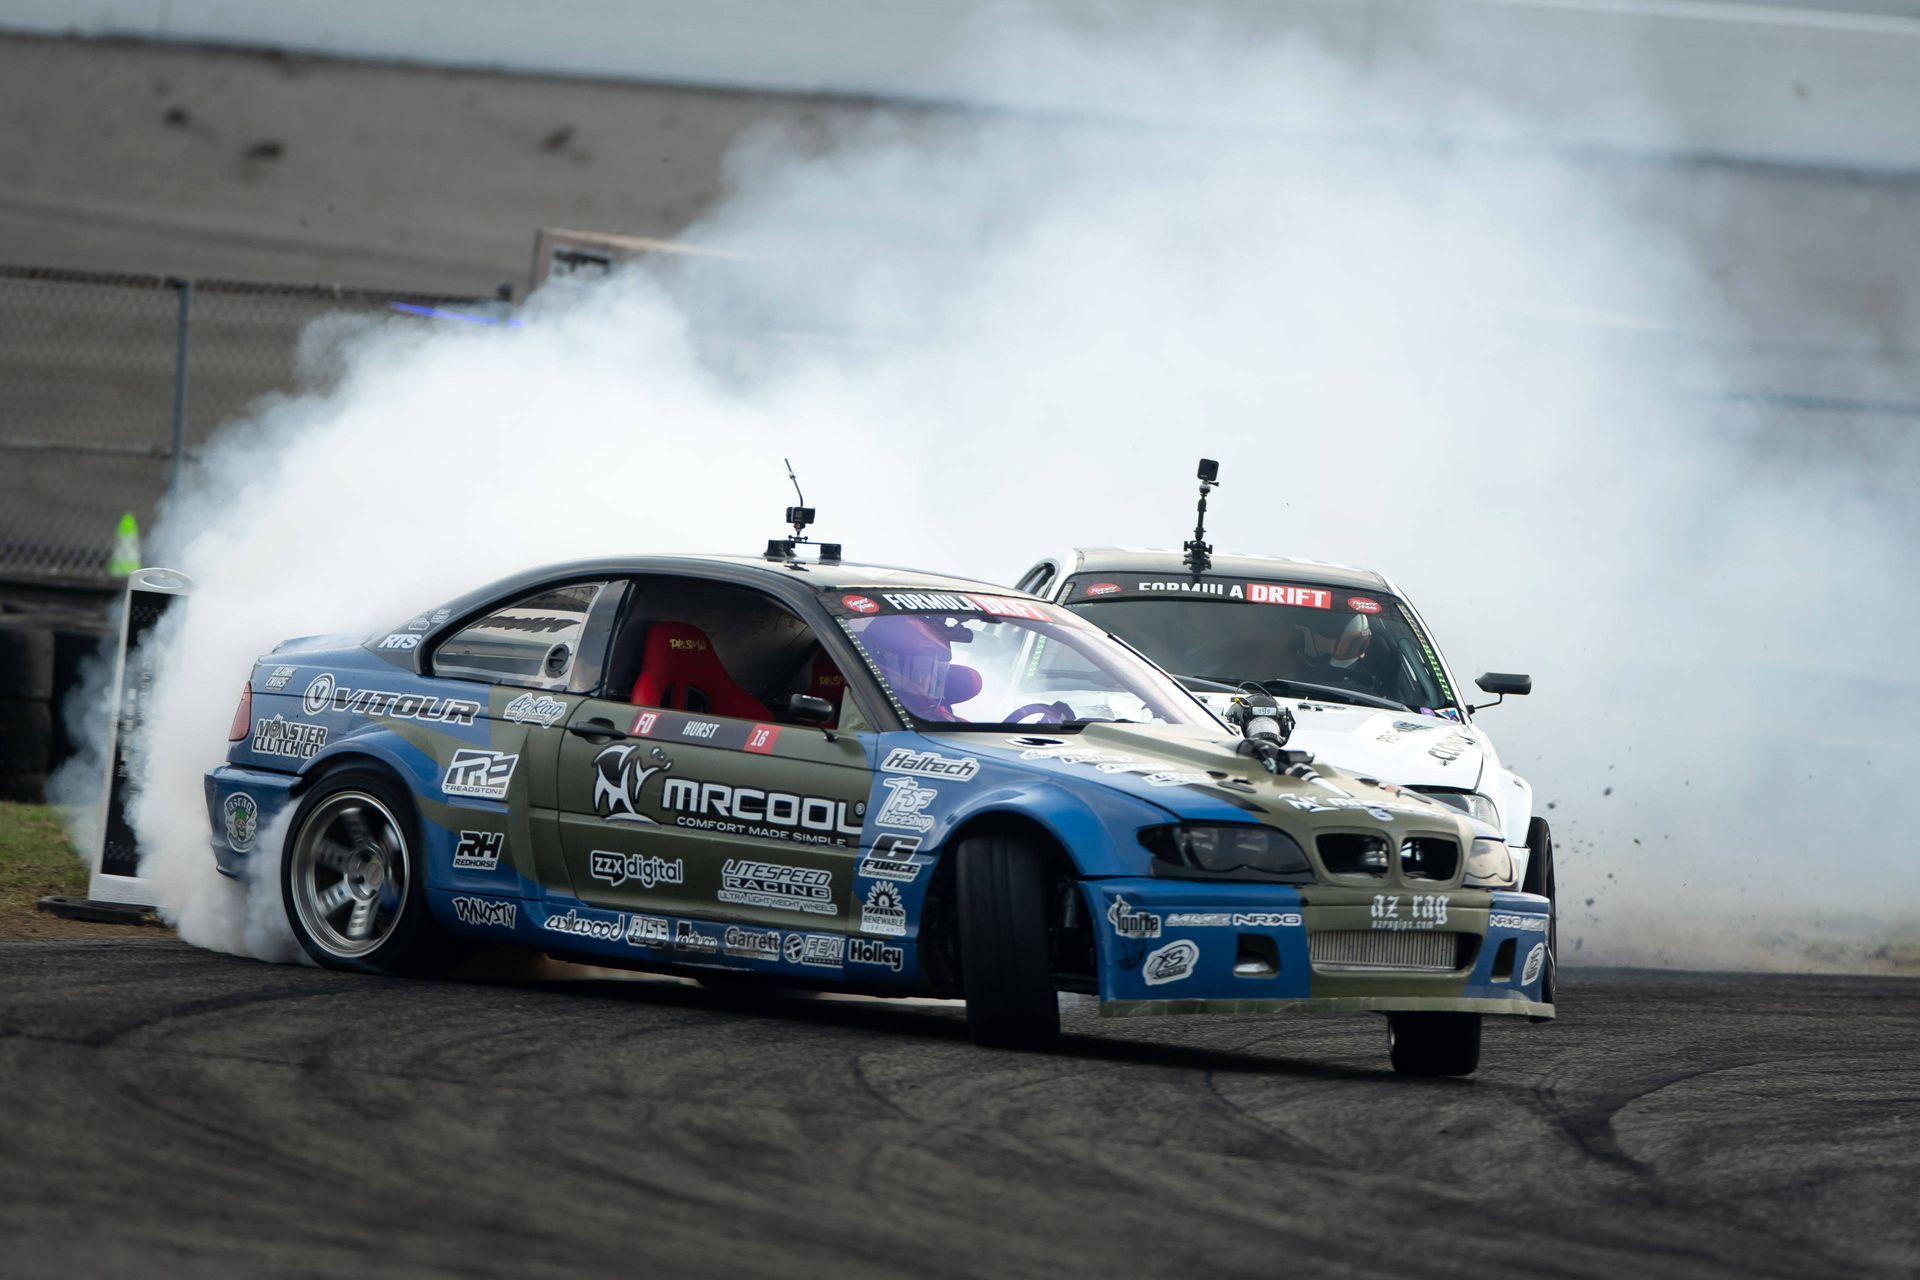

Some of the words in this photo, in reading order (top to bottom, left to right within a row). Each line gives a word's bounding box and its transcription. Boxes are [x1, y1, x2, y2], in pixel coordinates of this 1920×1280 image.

[882, 593, 983, 611] FORMULA
[974, 597, 1045, 619] DRIFT
[1250, 584, 1326, 607] DRIFT
[377, 633, 422, 649] RTS
[332, 687, 481, 725] VITOUR
[256, 720, 327, 744] MONSTER
[634, 712, 657, 734] FD
[682, 720, 721, 739] HURST
[750, 729, 770, 747] 16
[252, 736, 300, 757] CLUTCH
[886, 752, 975, 776] Haltech
[445, 784, 504, 795] TREADSTONE
[676, 816, 746, 834] COMFORT
[748, 826, 789, 840] MADE
[792, 833, 847, 847] SIMPLE
[457, 832, 503, 858] RH
[455, 858, 495, 868] REDHORSE
[723, 860, 830, 886] LITESPEED
[726, 877, 829, 898] RACING
[454, 899, 516, 928] DYNOSTY
[863, 914, 904, 927] RENEWABLE
[1371, 894, 1400, 918] az
[1412, 895, 1450, 924] rag
[545, 911, 624, 941] wilwood
[629, 918, 668, 940] RISE
[726, 928, 779, 950] Garrett
[850, 940, 904, 971] Holley
